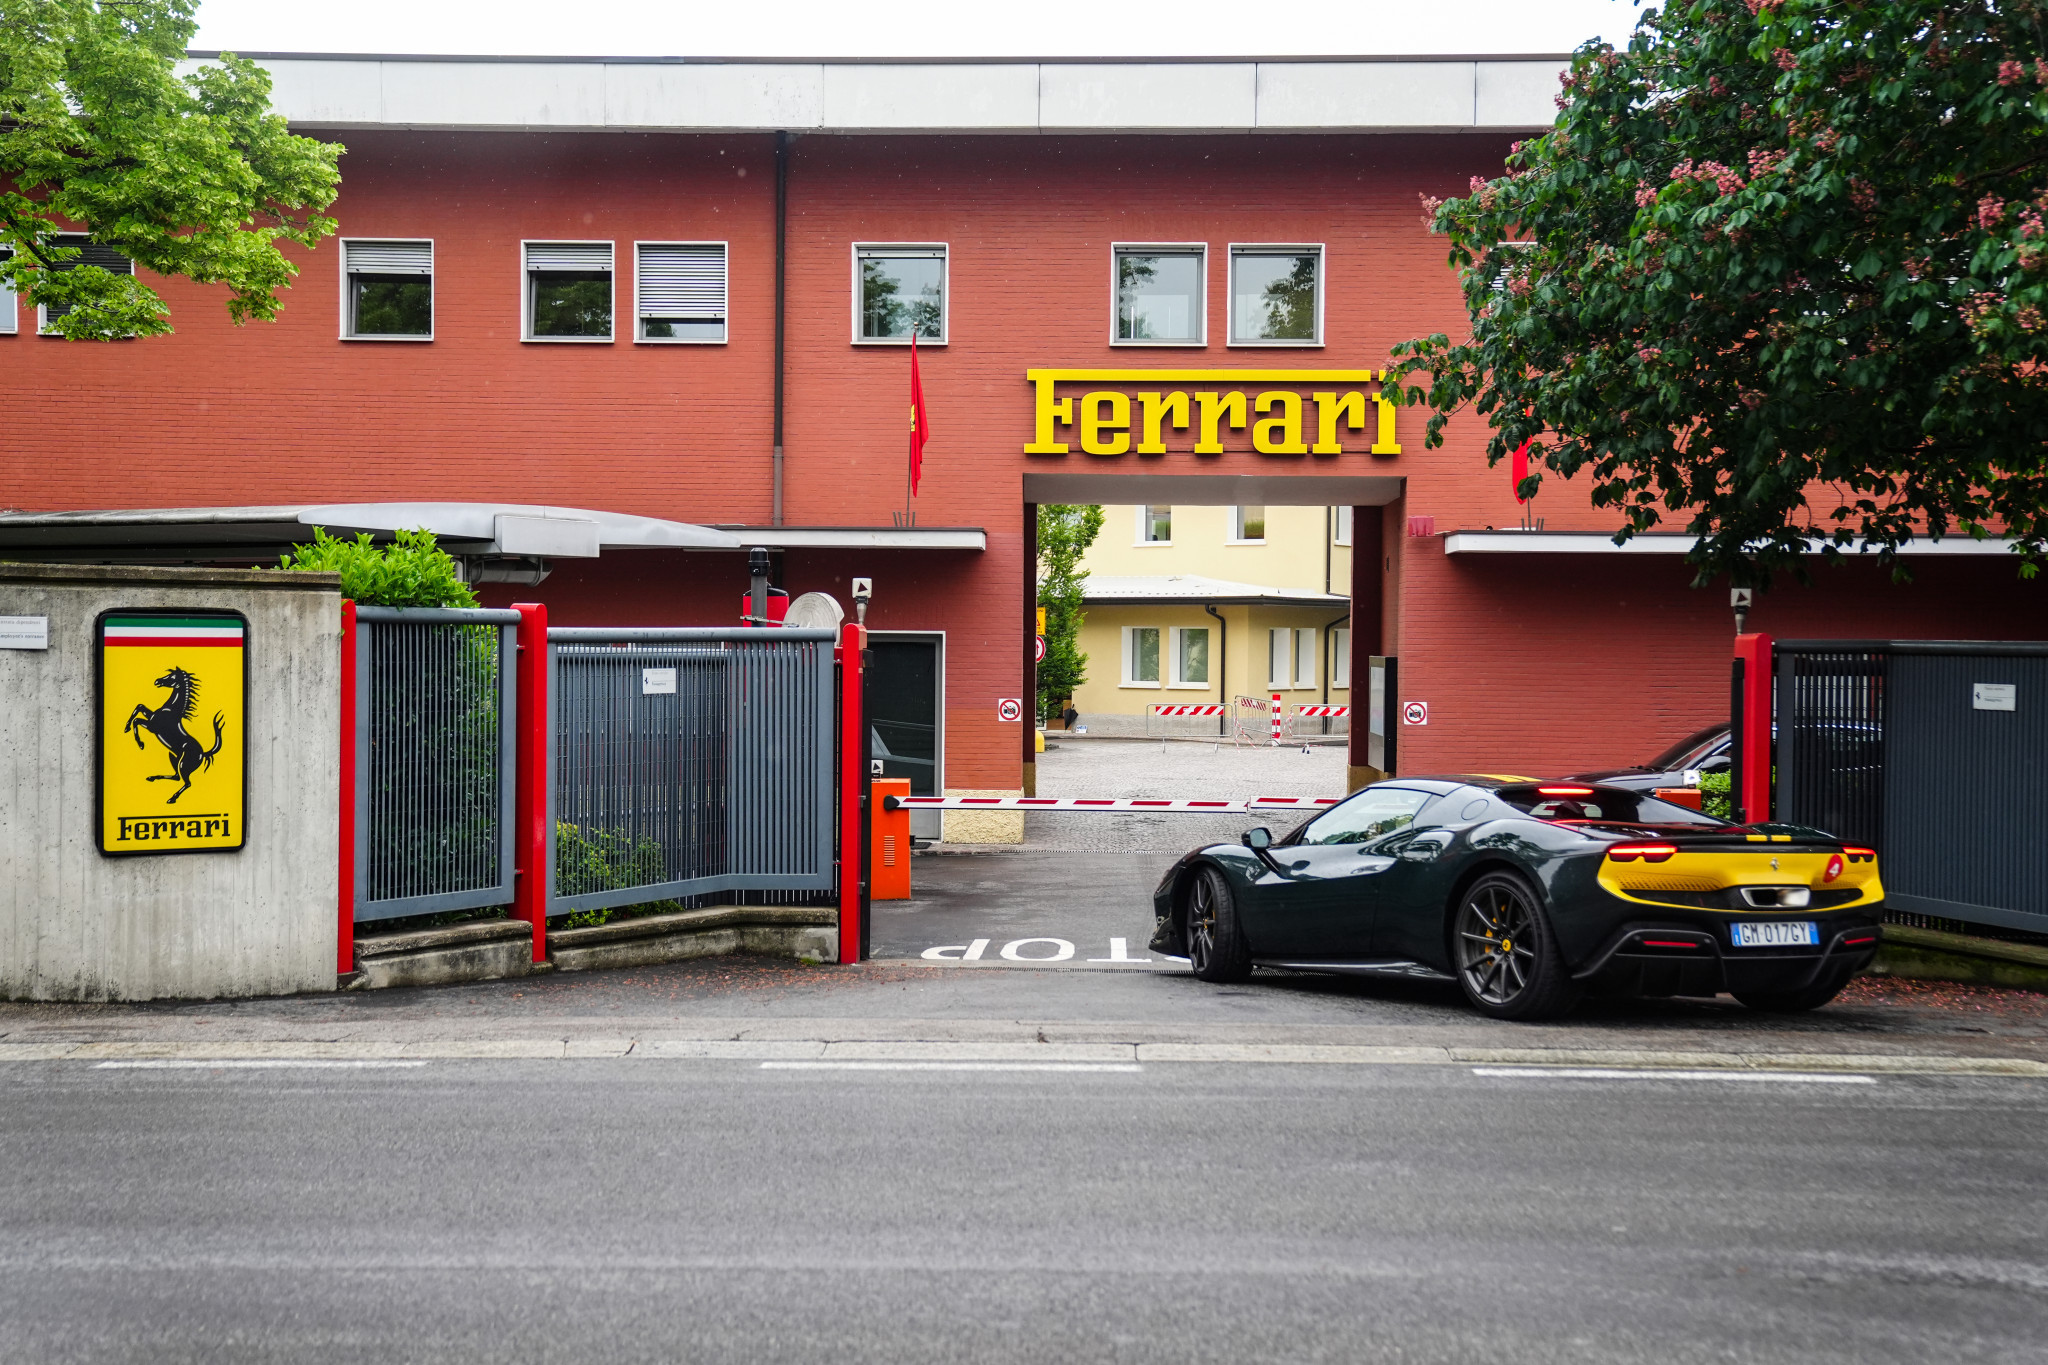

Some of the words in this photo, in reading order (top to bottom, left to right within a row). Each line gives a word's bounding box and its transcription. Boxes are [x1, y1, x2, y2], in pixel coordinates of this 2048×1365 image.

[1023, 368, 1402, 455] Ferrari
[116, 813, 231, 841] Ferrari
[1829, 863, 1840, 877] 4
[1741, 924, 1760, 943] GM
[1764, 923, 1807, 943] 017GY
[920, 936, 1192, 964] TOP
